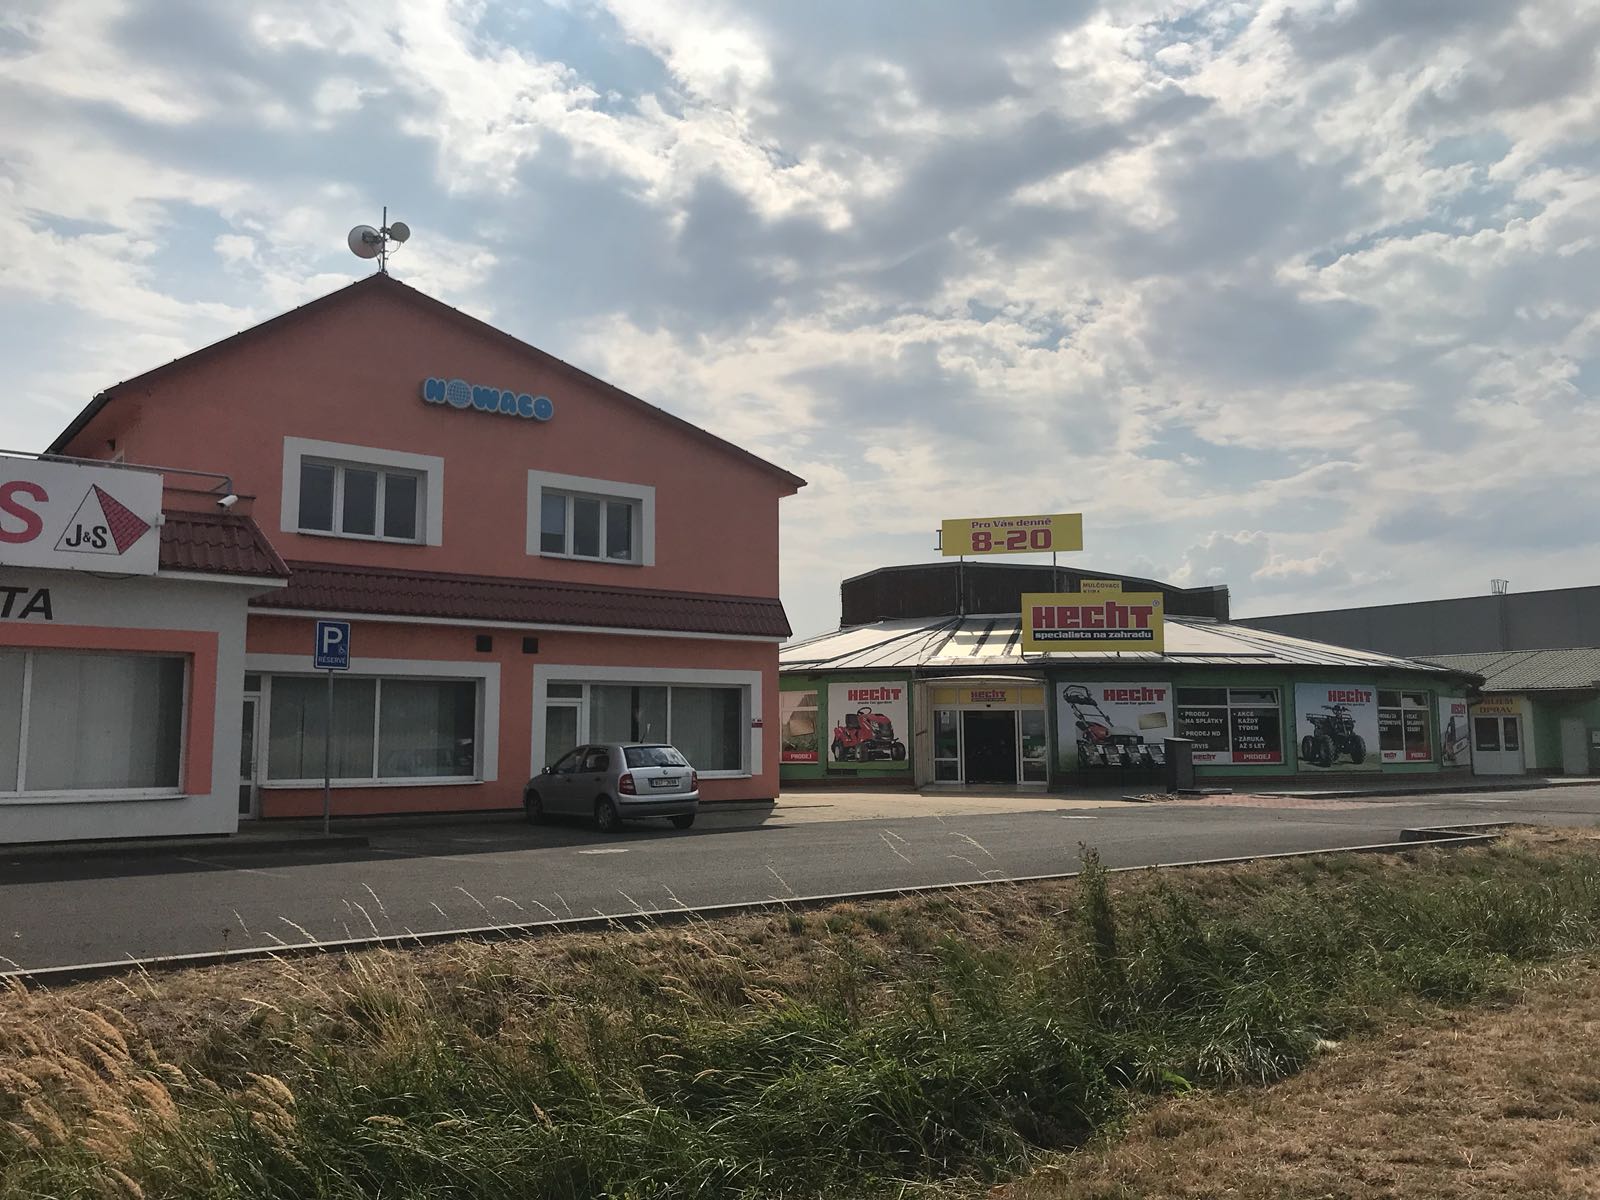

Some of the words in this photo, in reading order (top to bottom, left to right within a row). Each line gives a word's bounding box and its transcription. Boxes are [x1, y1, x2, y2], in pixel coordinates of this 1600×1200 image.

[971, 521, 990, 529] Pro
[993, 519, 1014, 528] Vás
[65, 523, 108, 549] J&S
[971, 529, 1052, 552] 8-20
[323, 626, 343, 654] P
[1034, 630, 1092, 640] specialista
[1108, 630, 1152, 639] zahradu
